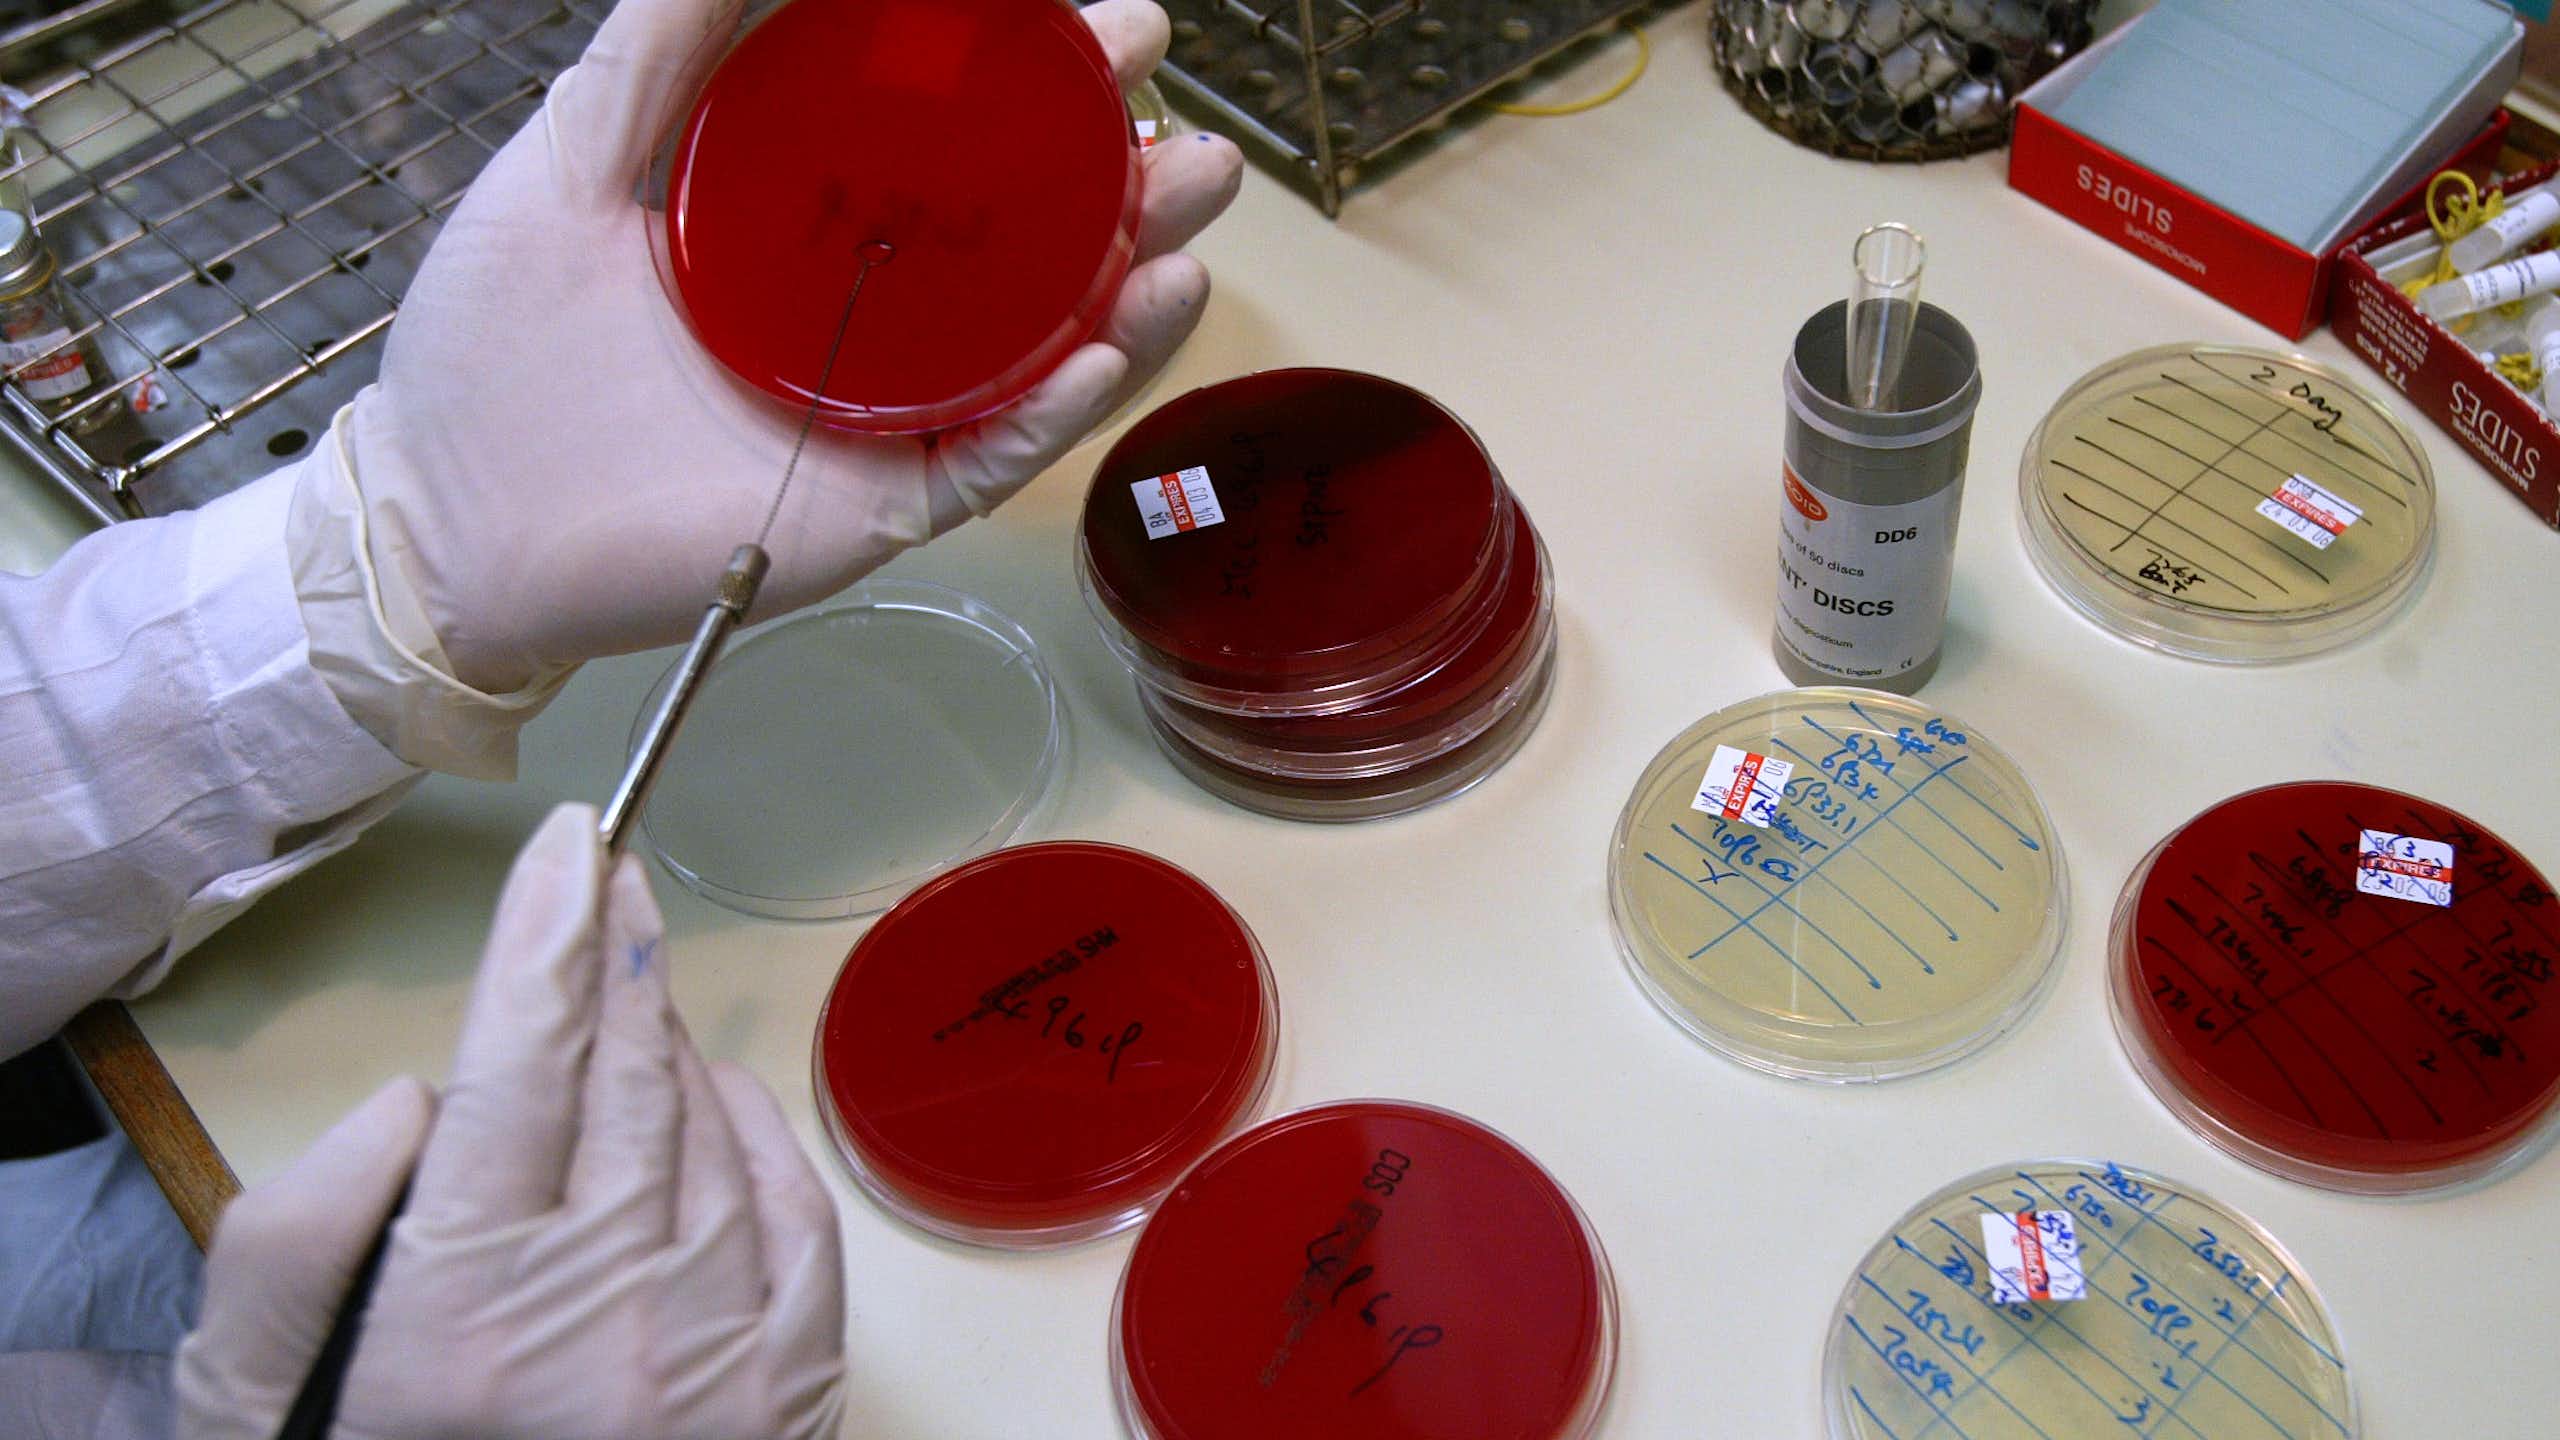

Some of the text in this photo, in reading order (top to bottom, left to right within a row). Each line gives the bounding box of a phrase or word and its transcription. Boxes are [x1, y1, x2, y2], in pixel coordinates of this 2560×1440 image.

[2076, 164, 2174, 234] SLIDES
[2250, 366, 2276, 386] 2
[2449, 380, 2541, 480] SLIDES
[2452, 416, 2529, 492] MICROSCOPE
[1180, 466, 1203, 485] 06
[1186, 484, 1209, 505] 03
[1163, 479, 1191, 526] EXPIRES
[2281, 490, 2338, 530] EXPIRES
[1874, 526, 1919, 545] DD6
[1826, 558, 1865, 578] discs
[1812, 587, 1895, 618] DISCS
[1727, 759, 1760, 812] EXPIRES
[1362, 1147, 1412, 1198] COS
